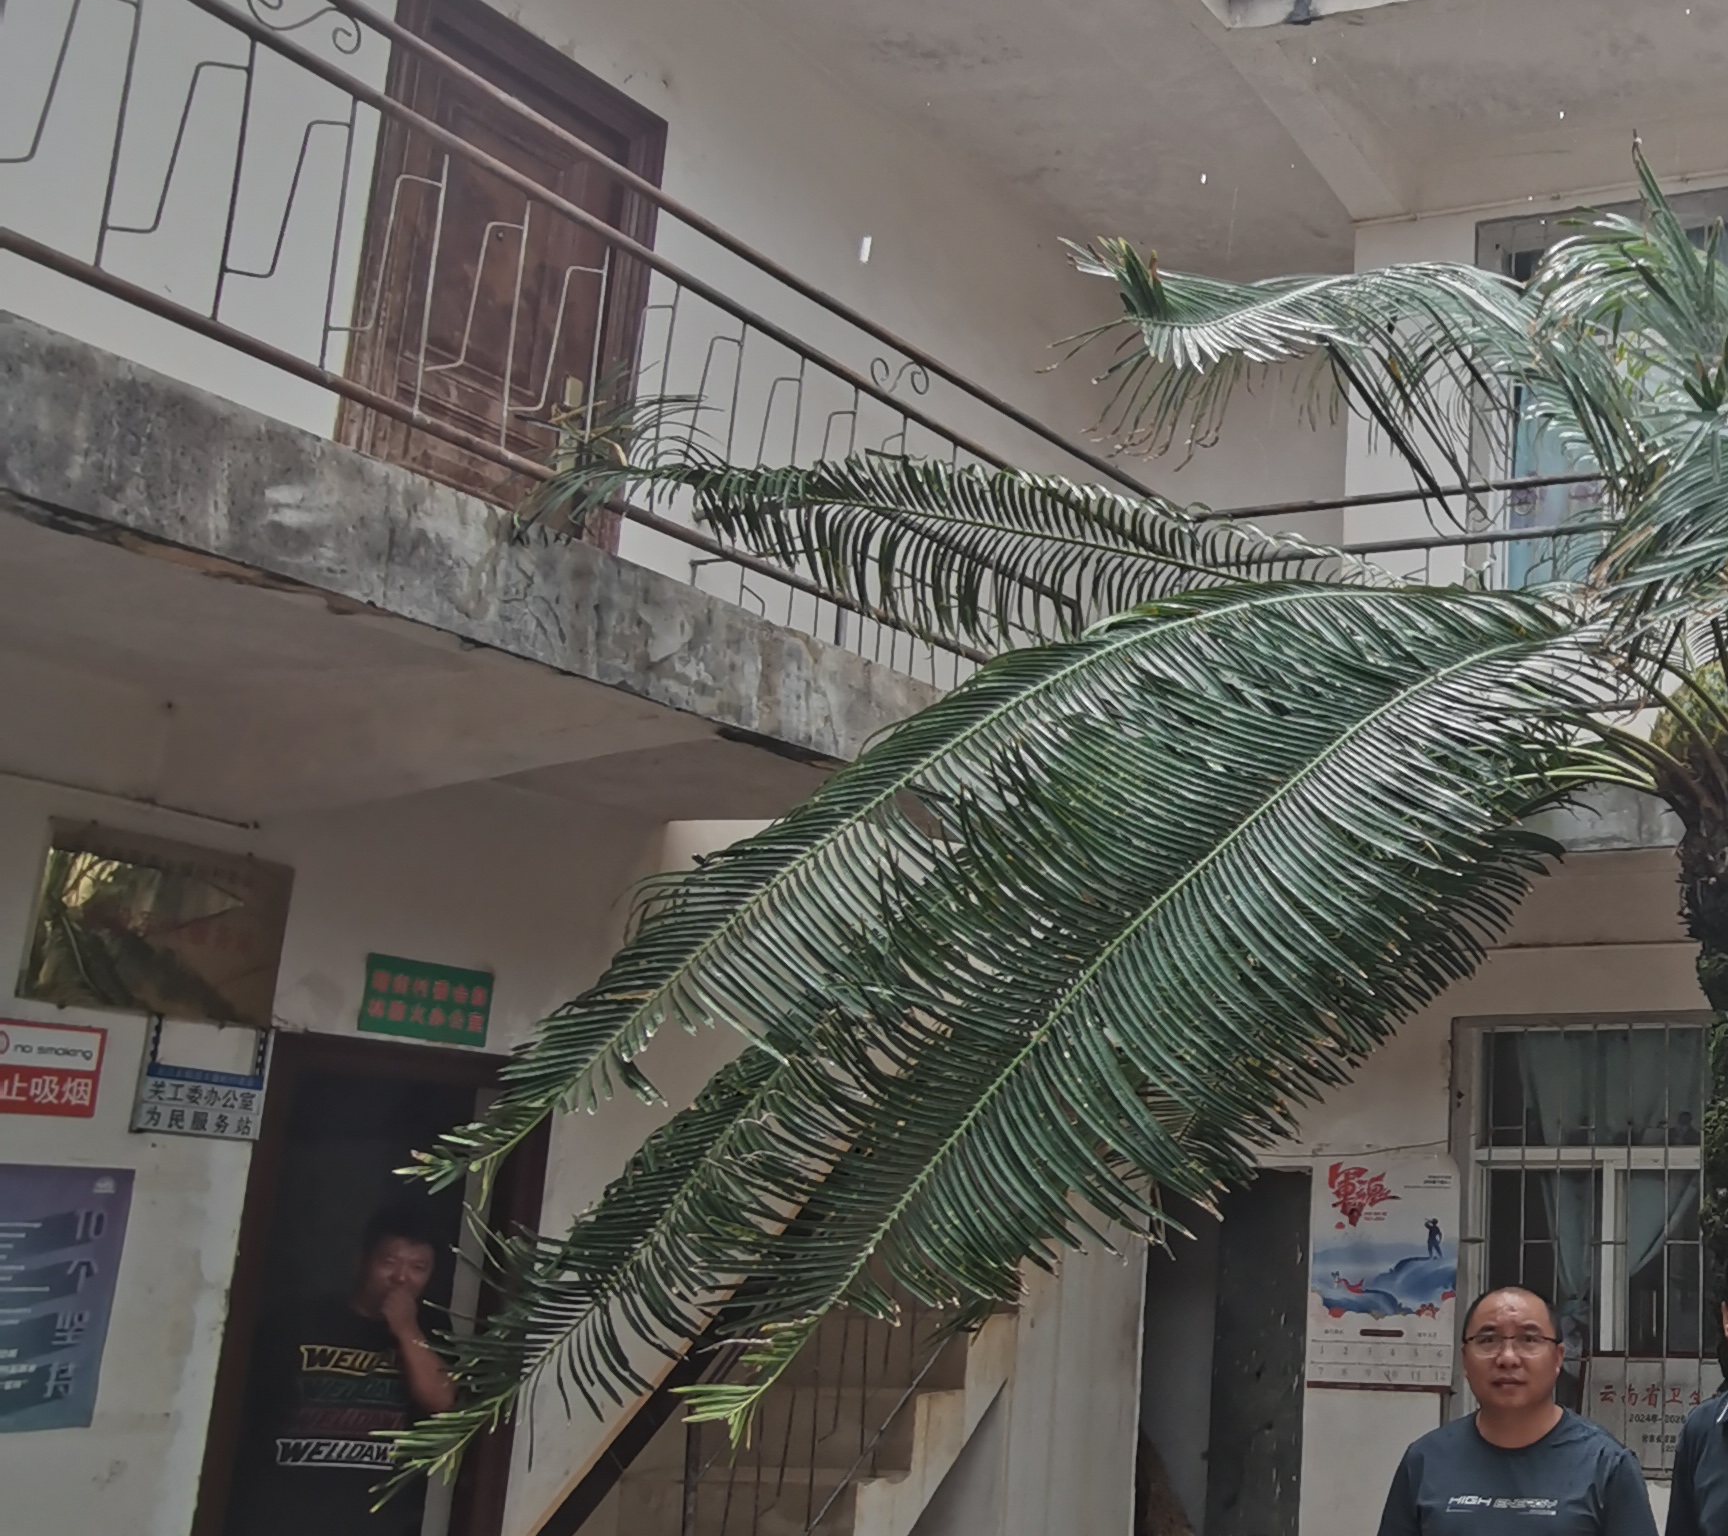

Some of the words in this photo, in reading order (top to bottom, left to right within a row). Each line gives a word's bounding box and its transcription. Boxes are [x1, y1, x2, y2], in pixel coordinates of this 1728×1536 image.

[13, 1043, 34, 1054] no
[37, 1045, 94, 1061] smoking
[0, 1072, 93, 1106] 止吸烟
[147, 1080, 257, 1112] 关工委办公室
[144, 1105, 253, 1136] 为民服务站
[1600, 1383, 1717, 1408] 云南省卫生
[276, 1438, 397, 1466] WELLDAW
[1448, 1495, 1492, 1506] HIGH
